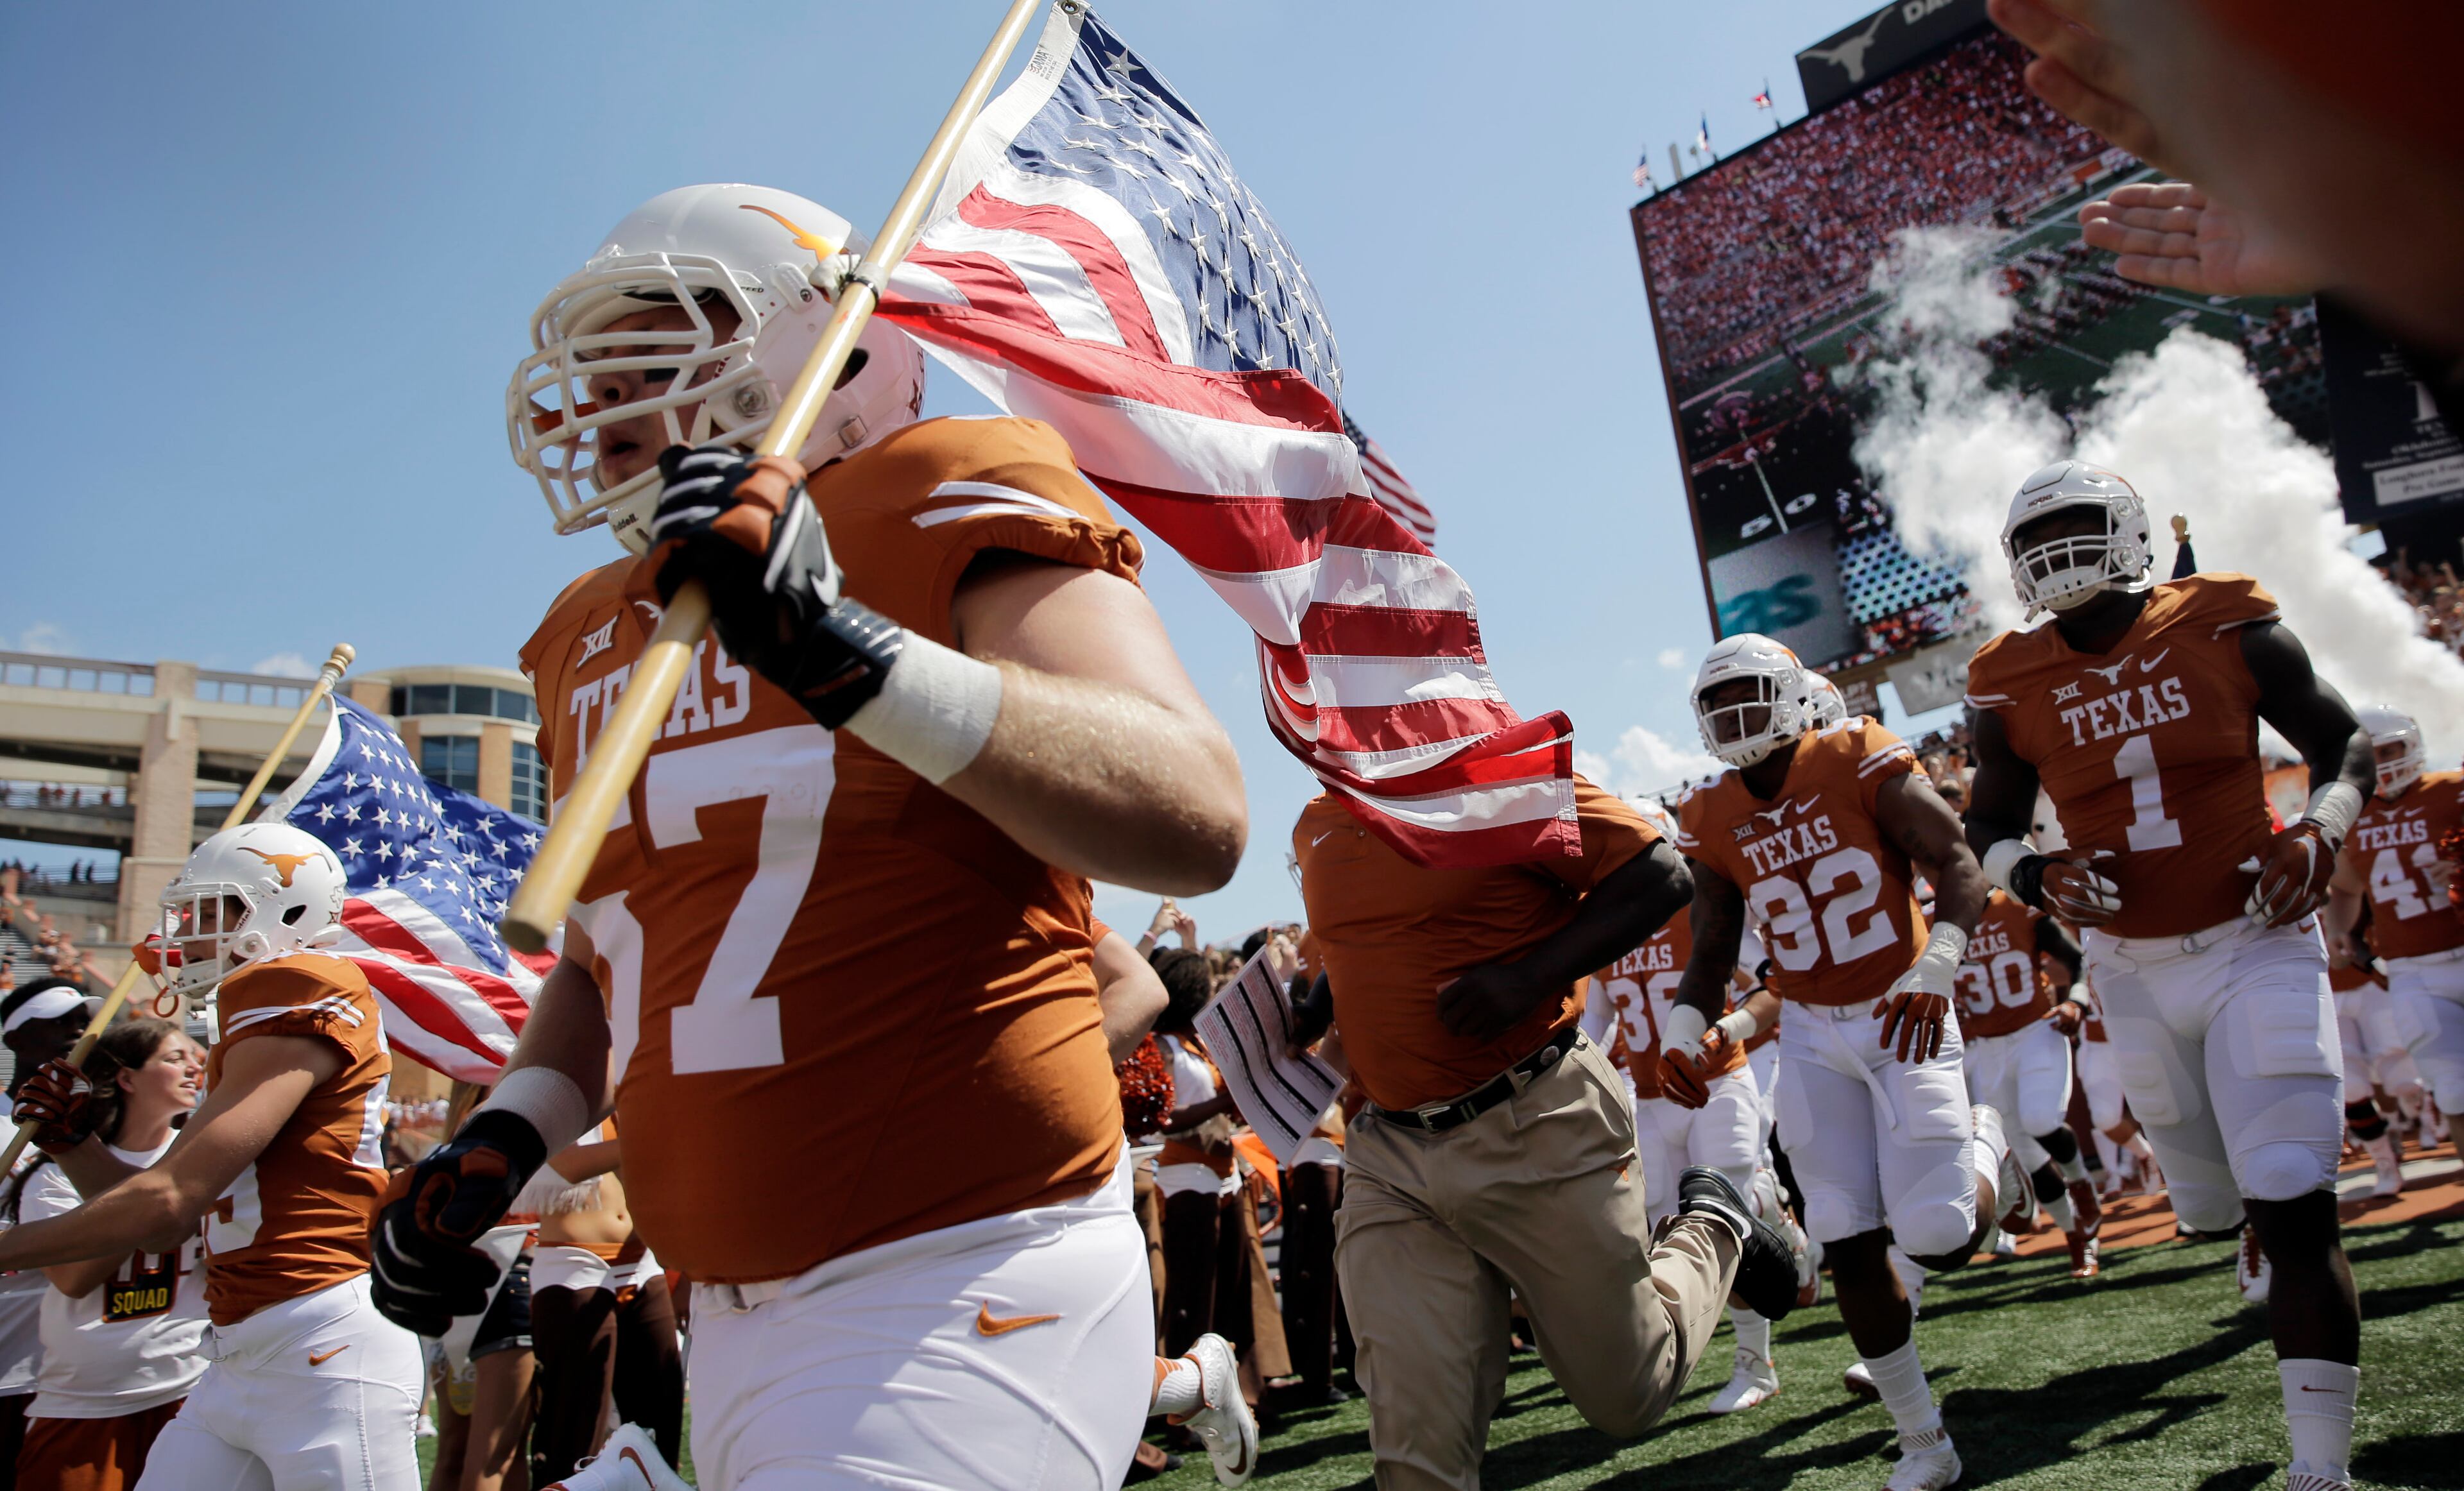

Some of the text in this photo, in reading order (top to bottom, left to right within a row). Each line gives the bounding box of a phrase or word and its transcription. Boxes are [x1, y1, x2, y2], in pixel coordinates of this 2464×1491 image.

[1903, 0, 1953, 25] DA
[570, 640, 750, 773] TEAS
[2051, 681, 2082, 704] XII
[2060, 676, 2190, 746] TEXAS
[2113, 734, 2182, 851] 1
[1741, 815, 1838, 876] TEXAS
[2357, 819, 2428, 851] TEXAS
[1749, 846, 1899, 970] 92
[2369, 842, 2452, 920] 41
[1963, 932, 2010, 960] EXAS
[1954, 950, 2035, 1014] 30
[112, 1288, 168, 1314] SQUAD
